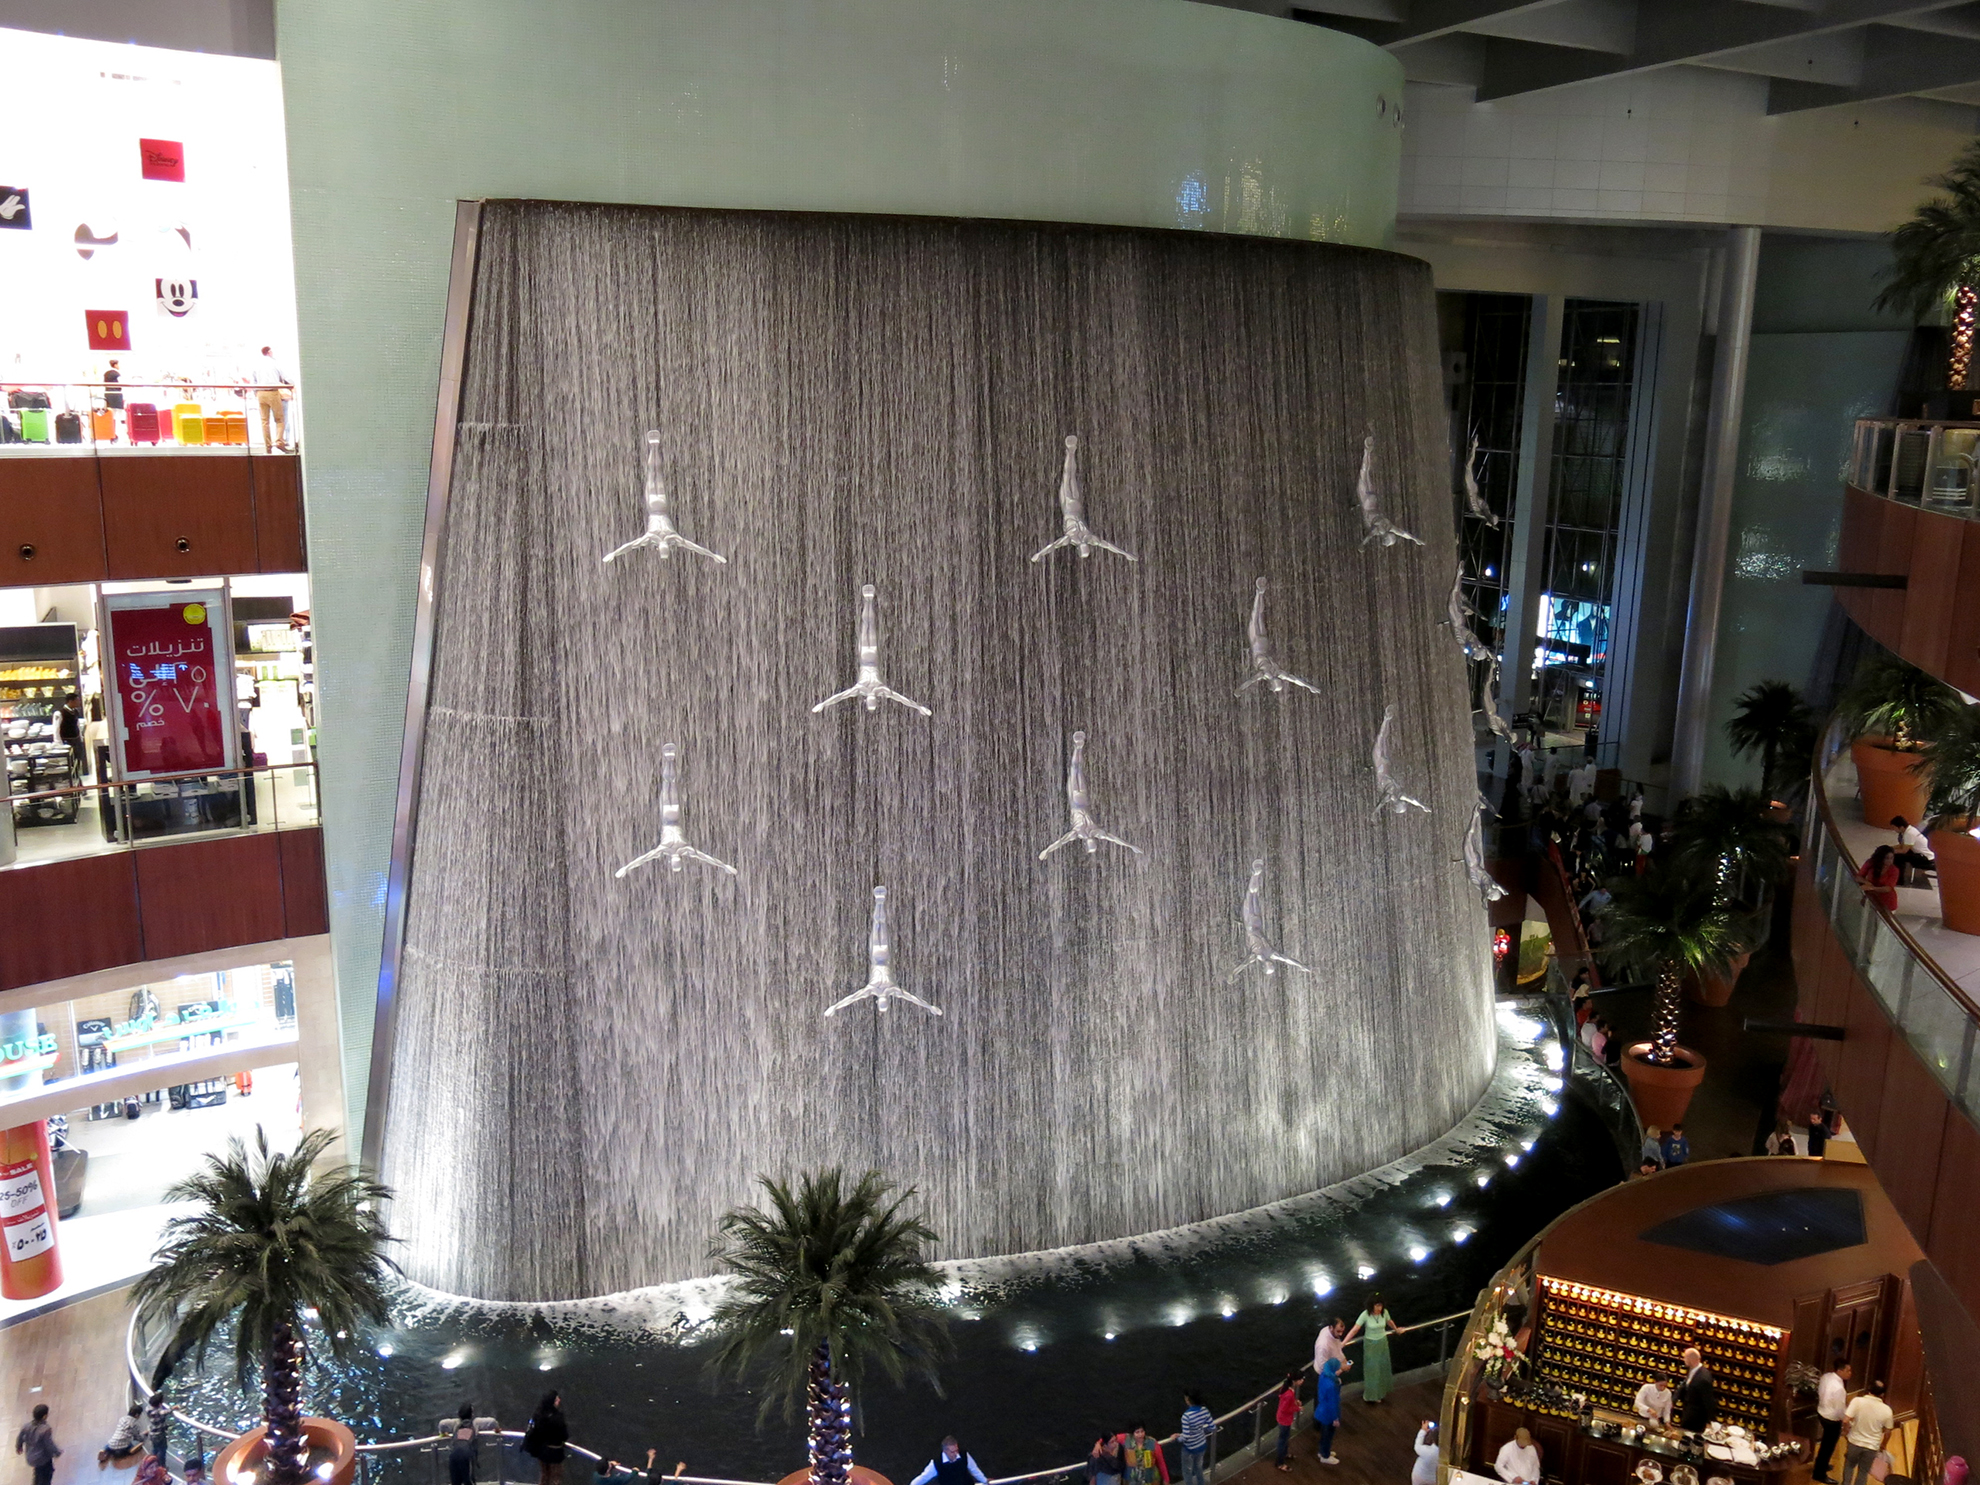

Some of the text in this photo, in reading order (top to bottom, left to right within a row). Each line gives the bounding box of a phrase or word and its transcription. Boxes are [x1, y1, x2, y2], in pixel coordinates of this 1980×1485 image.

[126, 638, 205, 657] تنزيلات
[0, 1033, 58, 1062] USE
[10, 1163, 33, 1175] SALE
[11, 1197, 27, 1207] OFF
